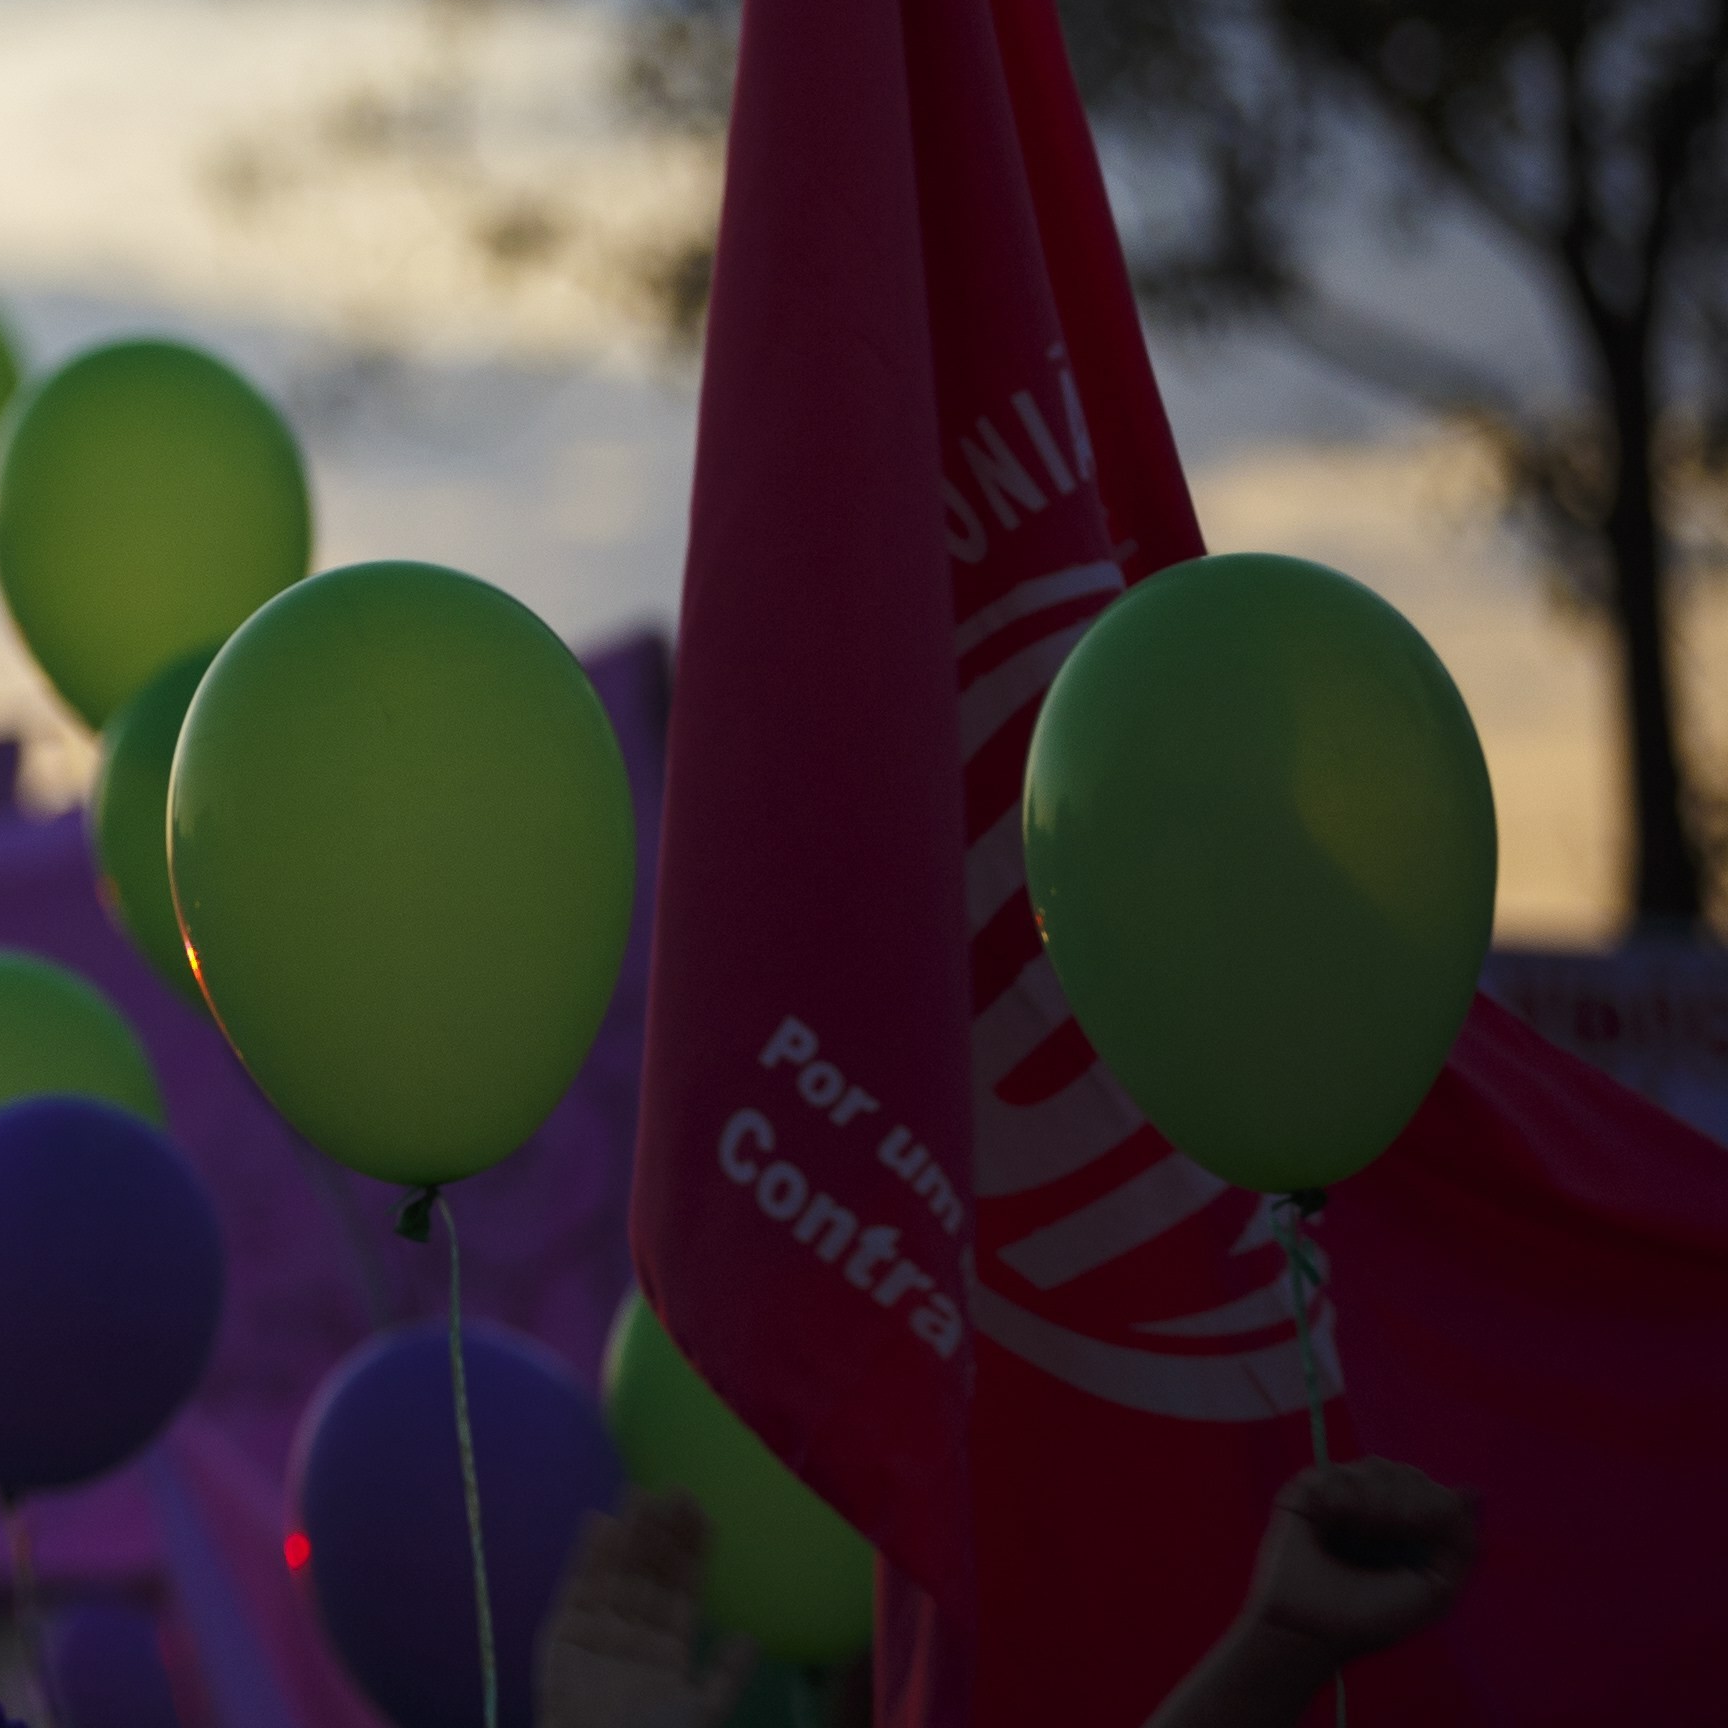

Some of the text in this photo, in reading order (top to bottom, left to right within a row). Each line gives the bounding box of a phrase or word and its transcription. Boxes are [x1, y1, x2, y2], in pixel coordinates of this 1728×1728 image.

[716, 1106, 964, 1360] Contra
[757, 1013, 965, 1236] Por um
